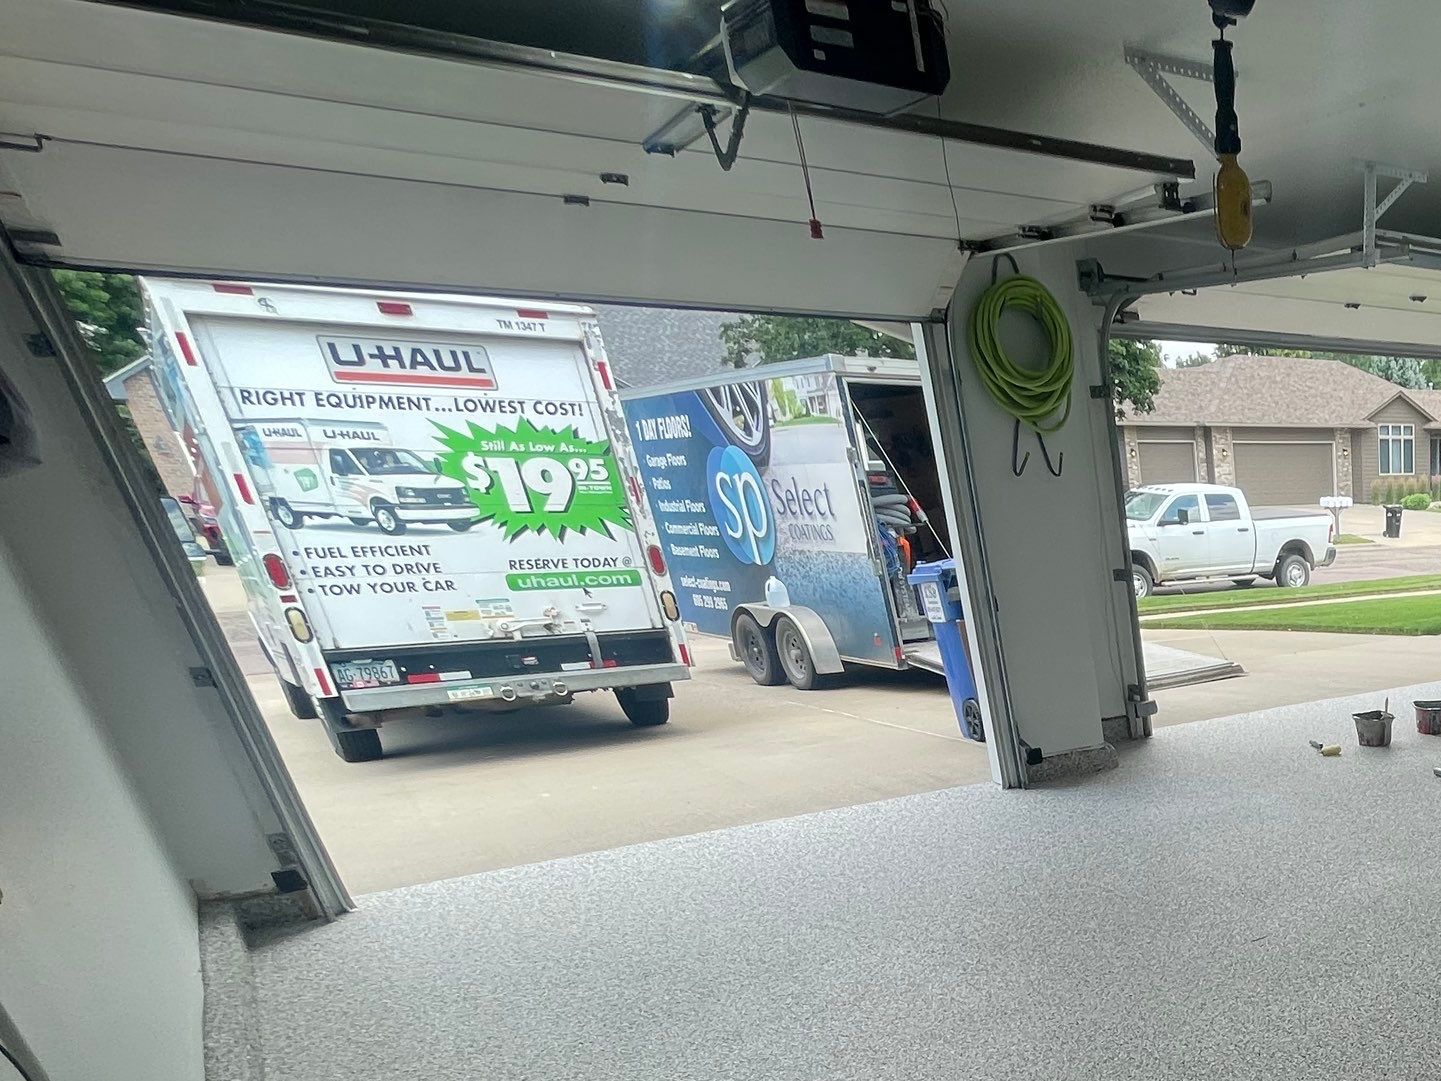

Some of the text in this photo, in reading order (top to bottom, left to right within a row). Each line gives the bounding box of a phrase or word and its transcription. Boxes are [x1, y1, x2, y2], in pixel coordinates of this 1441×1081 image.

[496, 319, 514, 331] TM
[327, 341, 486, 373] U-HAUL
[240, 388, 306, 407] RIGHT
[532, 400, 584, 417] COST!
[262, 427, 381, 441] U-HAUL U-HAUL
[635, 414, 692, 441] 1 DAY FLOORS!
[480, 440, 587, 453] Still As Low As...
[646, 453, 687, 469] Garage Floors
[652, 477, 672, 490] Patios
[771, 476, 836, 518] Select
[658, 500, 706, 513] Industrial Floors
[665, 522, 720, 536] Commercial Floors
[788, 522, 835, 542] COATINGS
[304, 544, 433, 560] FUEL EFFICIENT
[670, 543, 720, 559] Basement Floors
[311, 562, 443, 578] EASY TO DRIVE
[508, 558, 569, 571] RESERVE
[572, 556, 619, 569] TODAY
[318, 578, 458, 596] TOW YOUR CAR
[517, 573, 633, 589] uhaul.com
